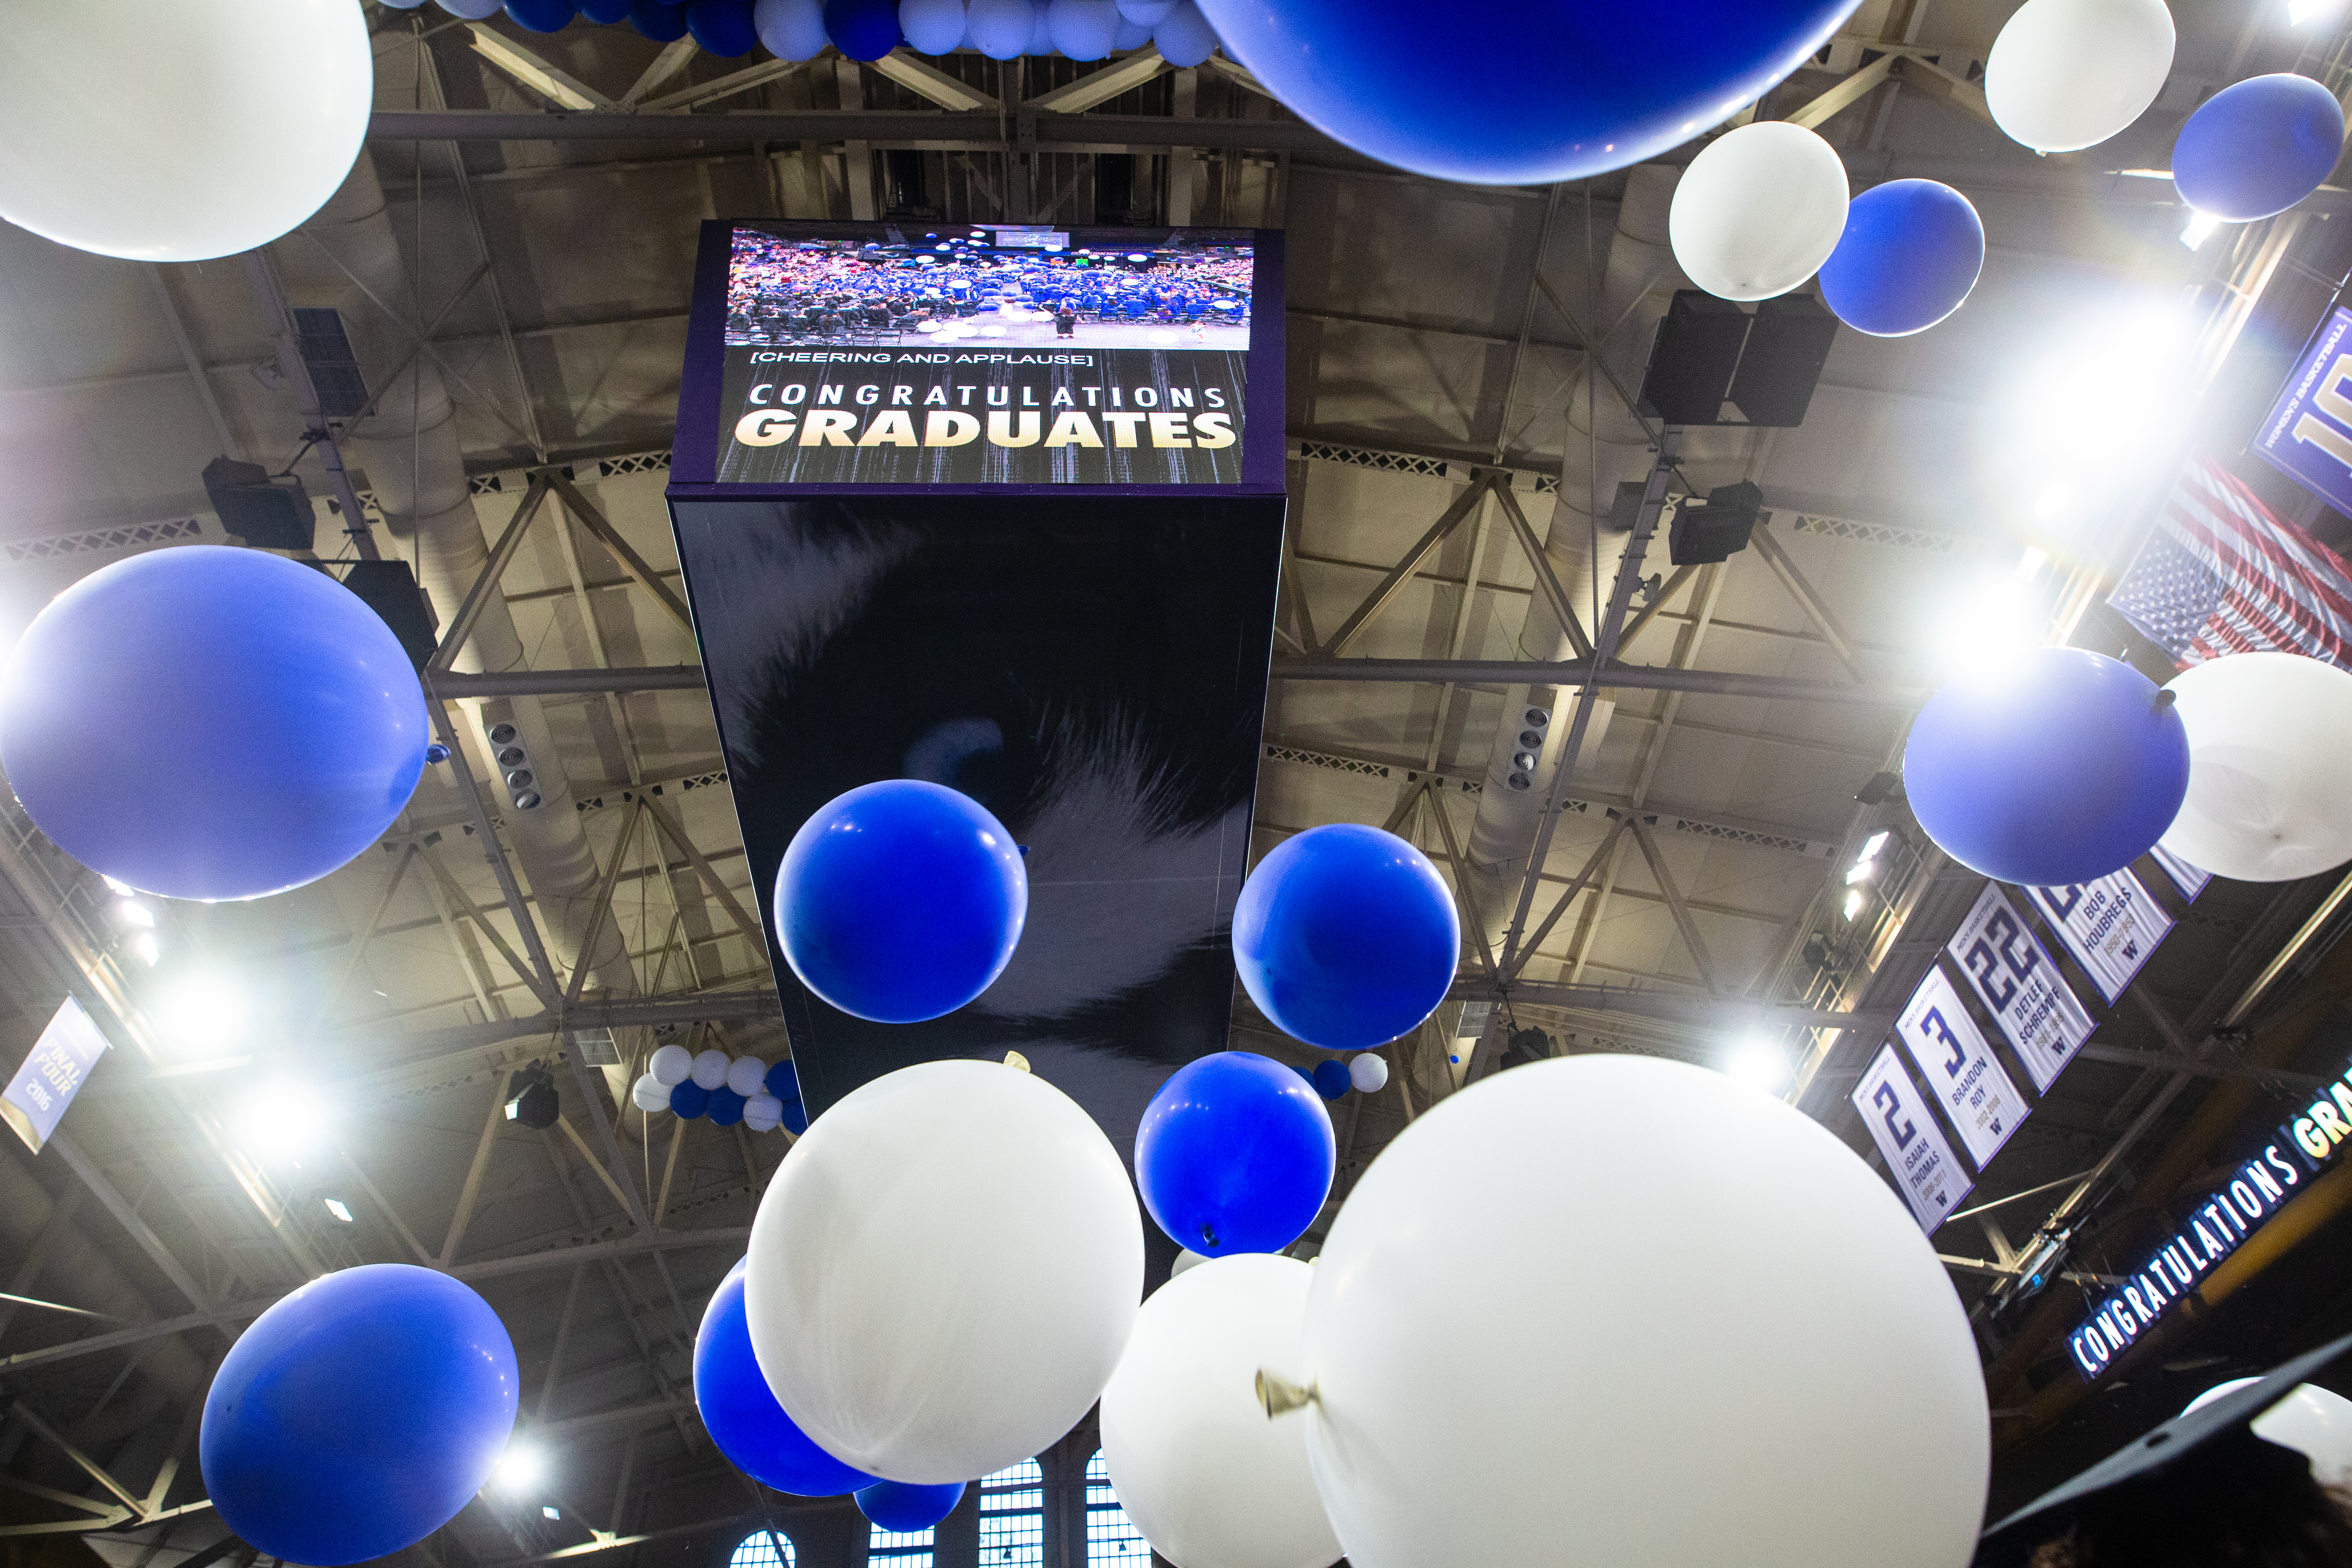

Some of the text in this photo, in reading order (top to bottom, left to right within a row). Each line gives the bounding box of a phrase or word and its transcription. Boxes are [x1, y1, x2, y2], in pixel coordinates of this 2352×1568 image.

[750, 352, 1093, 367] [CHEERING AND APPLAUSE]
[749, 384, 1225, 408] CONGRATULATIONS
[2265, 324, 2347, 448] WOMEN'S BASKETBALL
[735, 409, 1236, 449] GRADUATES
[1968, 891, 1996, 934] BASKETBALL
[2081, 887, 2132, 954] HOUBREGS
[2083, 890, 2106, 920] BOB
[1964, 905, 2039, 1013] 22
[2121, 939, 2138, 960] W
[1915, 978, 1940, 1014] BASKETBALL
[2014, 979, 2043, 1020] DETLEF
[2019, 985, 2060, 1044] SCHREMPF
[42, 1036, 81, 1085] FINAL
[1920, 1005, 1967, 1079] 3
[2051, 1036, 2066, 1056] W
[33, 1051, 72, 1097] FOUR
[1868, 1055, 1891, 1088] BASKETBALL
[1951, 1056, 1987, 1105] BRANDON
[26, 1078, 53, 1111] 2016
[1969, 1085, 1987, 1109] ROY
[1873, 1080, 1916, 1152] 2
[1989, 1117, 2002, 1136] W
[1904, 1138, 1929, 1171] ISAIAH
[1910, 1150, 1940, 1189] THOMAS
[1935, 1190, 1948, 1207] W
[2072, 1067, 2352, 1372] CONGRATULATIONS GRA
